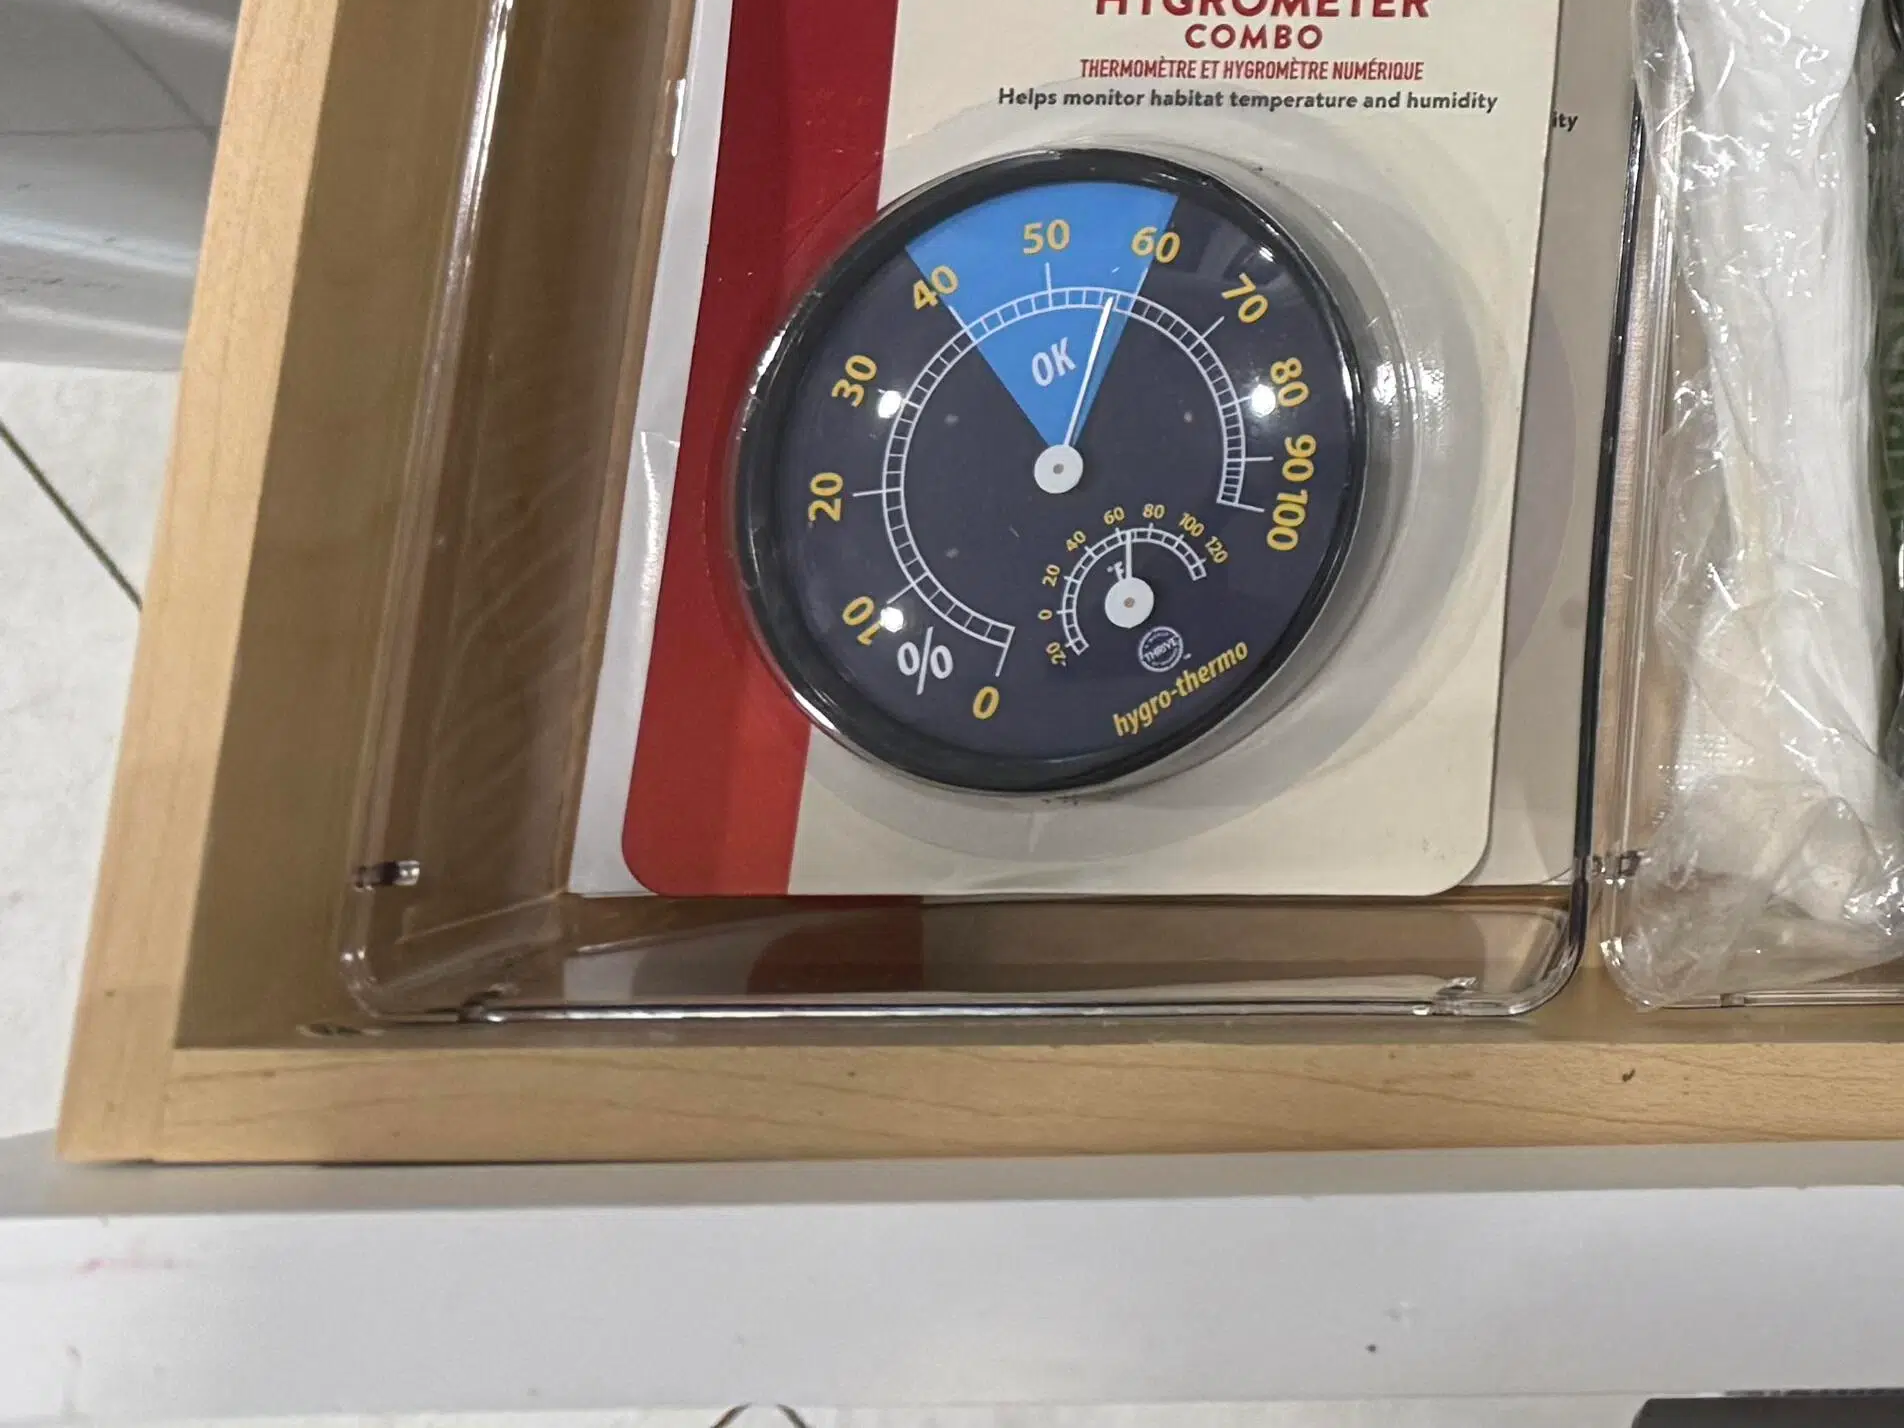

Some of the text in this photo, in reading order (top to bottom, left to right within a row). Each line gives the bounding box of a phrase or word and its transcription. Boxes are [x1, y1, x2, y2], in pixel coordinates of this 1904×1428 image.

[1185, 24, 1324, 51] COMBO
[1079, 55, 1425, 82] THERMOMÈTRE ET HYGROMÈTRE NUMÉRIQUE
[998, 87, 1499, 113] Helps monitor habitat temperature and humidity
[1022, 218, 1072, 255] 50
[1131, 227, 1181, 264] 60
[911, 264, 960, 312] 40
[1220, 272, 1269, 324] 70
[1031, 337, 1078, 387] OK
[831, 354, 878, 408] 30
[1269, 356, 1310, 408] 80
[1281, 434, 1317, 481] 90
[807, 471, 845, 523] 20
[1142, 503, 1166, 520] 80
[1102, 506, 1126, 526] 60
[1178, 512, 1205, 538] 100
[1265, 490, 1309, 552] 100
[1065, 530, 1087, 553] 40
[1204, 535, 1229, 565] 120
[1042, 563, 1061, 588] 20
[842, 595, 886, 647] 10
[1037, 608, 1053, 621] 0
[898, 625, 954, 696] %
[1143, 638, 1179, 664] THRIVE
[972, 685, 1000, 720] 0
[1112, 642, 1249, 737] hygro-thermo
